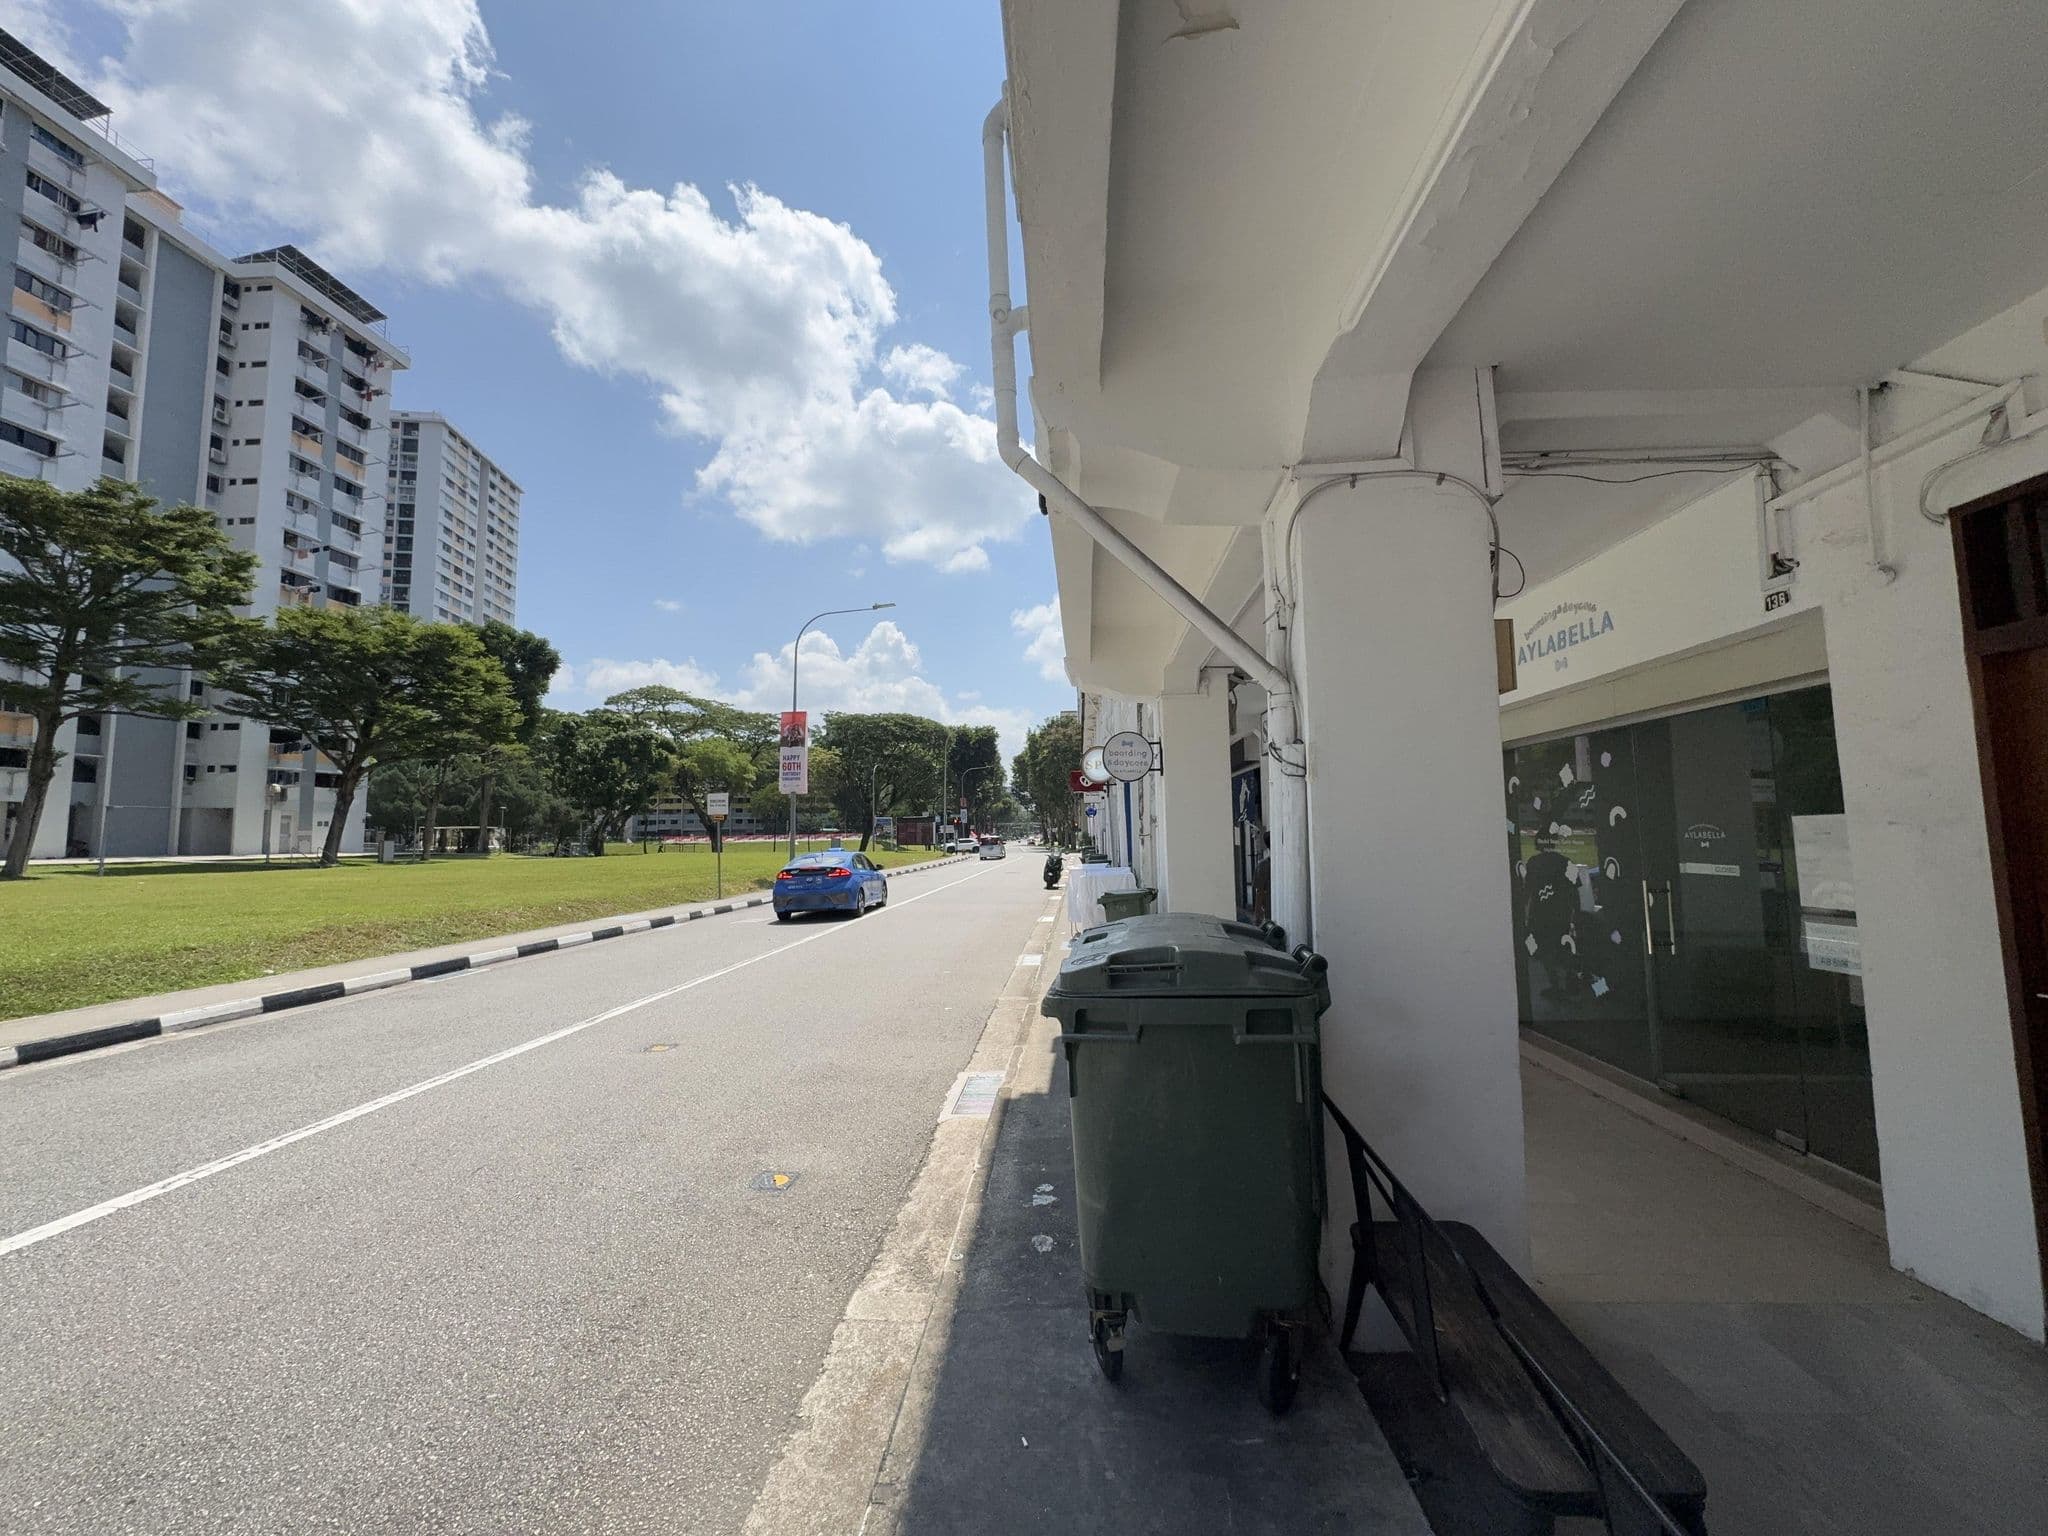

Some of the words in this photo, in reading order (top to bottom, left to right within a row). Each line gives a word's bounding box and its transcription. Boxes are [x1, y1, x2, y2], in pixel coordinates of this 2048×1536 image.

[1517, 610, 1614, 666] AYLABELLA
[1108, 749, 1147, 759] boarding
[782, 762, 801, 771] 60TH
